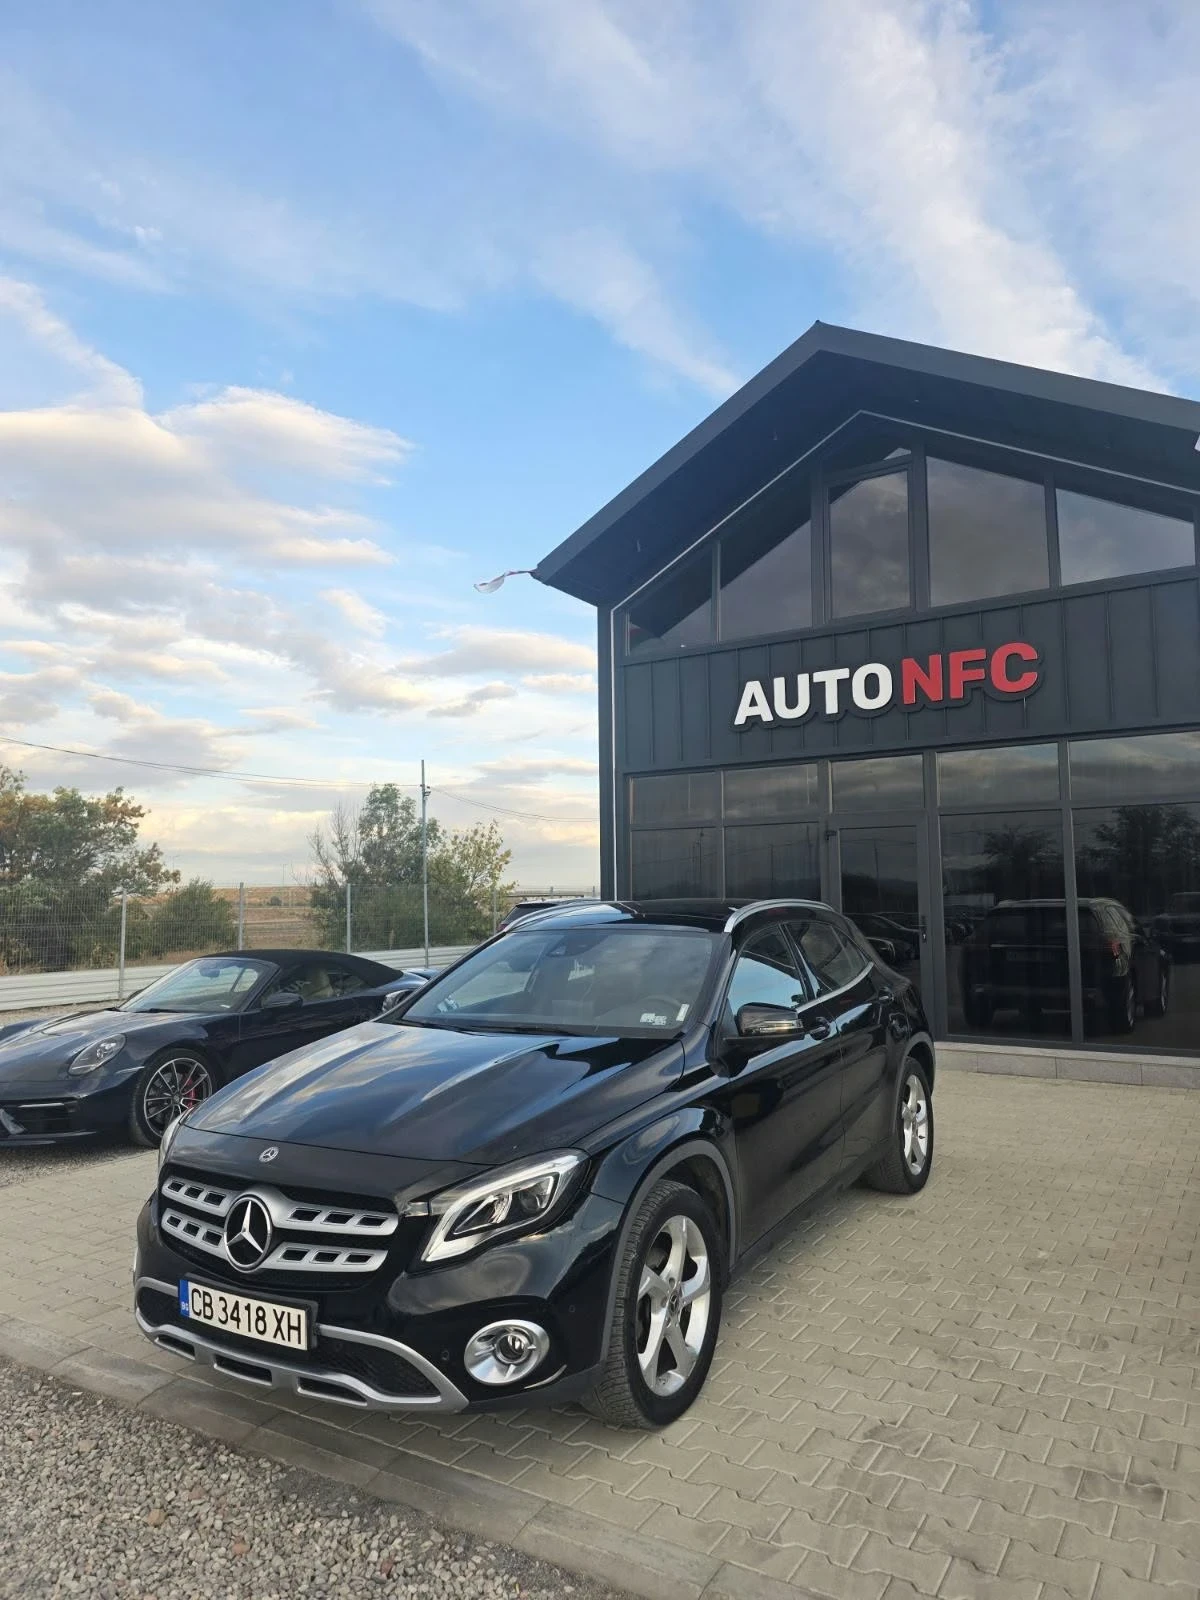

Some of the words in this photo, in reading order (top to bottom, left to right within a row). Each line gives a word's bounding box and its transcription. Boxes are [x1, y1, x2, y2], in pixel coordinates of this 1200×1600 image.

[734, 662, 893, 725] AUTO
[902, 642, 1038, 705] NFC
[191, 1288, 214, 1320] CB
[218, 1296, 267, 1335] 3418
[273, 1308, 302, 1344] XH
